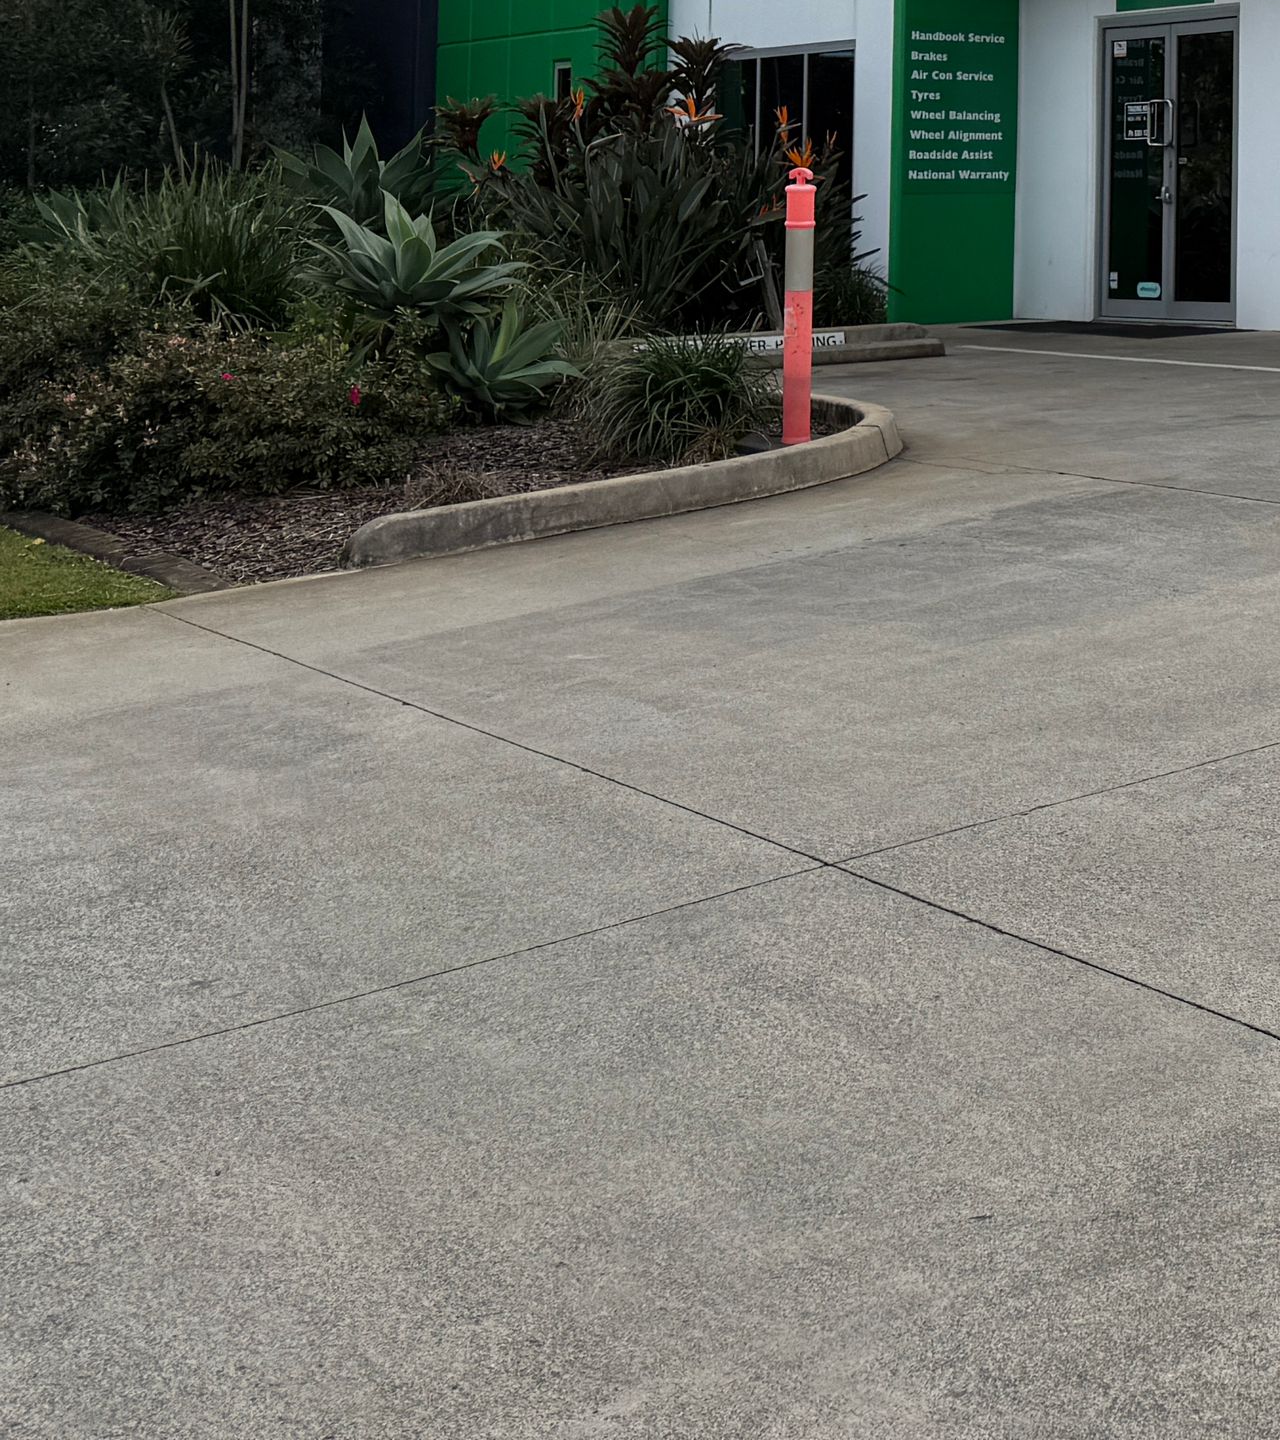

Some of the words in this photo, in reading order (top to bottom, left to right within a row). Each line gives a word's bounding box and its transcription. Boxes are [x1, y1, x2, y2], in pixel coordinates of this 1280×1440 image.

[912, 31, 965, 42] Handbook
[968, 33, 1005, 44] Service
[911, 51, 948, 61] Brakes
[911, 70, 928, 80] Air
[932, 70, 952, 80] Con
[956, 71, 994, 81] Service
[911, 90, 940, 102] Tyres
[910, 110, 944, 120] Wheel
[949, 110, 1000, 123] Balancing
[910, 130, 944, 140] Wheel
[948, 130, 1002, 142] Alignment
[909, 150, 958, 160] Roadside
[962, 150, 993, 160] Assist
[908, 170, 954, 180] National
[958, 170, 1009, 181] Warranty
